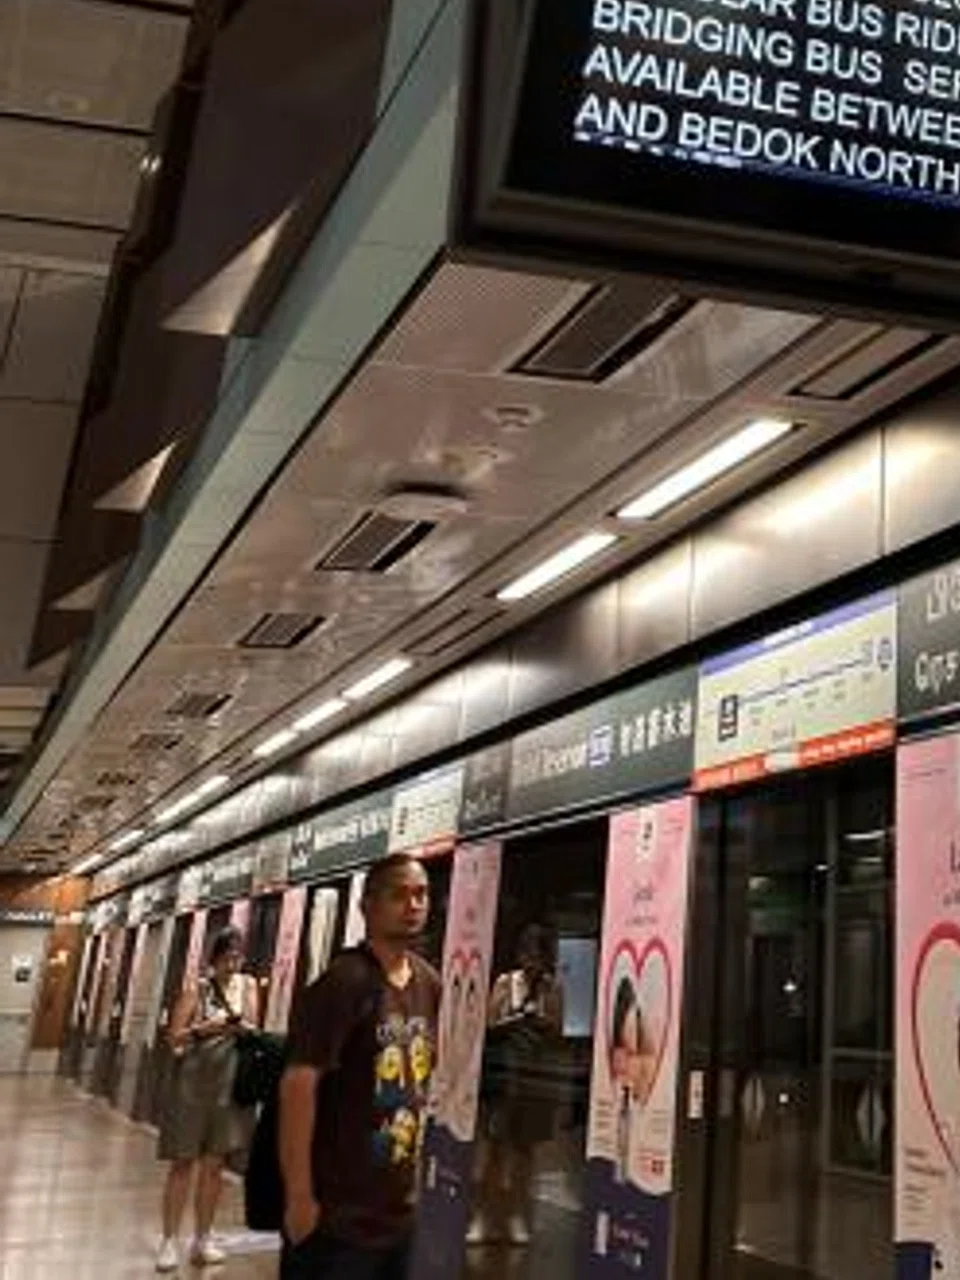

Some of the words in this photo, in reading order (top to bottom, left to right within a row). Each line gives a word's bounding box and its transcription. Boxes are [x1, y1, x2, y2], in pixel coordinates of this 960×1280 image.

[583, 44, 800, 117] AVAILABLE
[806, 38, 883, 84] BUS
[574, 95, 667, 141] AND
[679, 113, 821, 170] BEDOK
